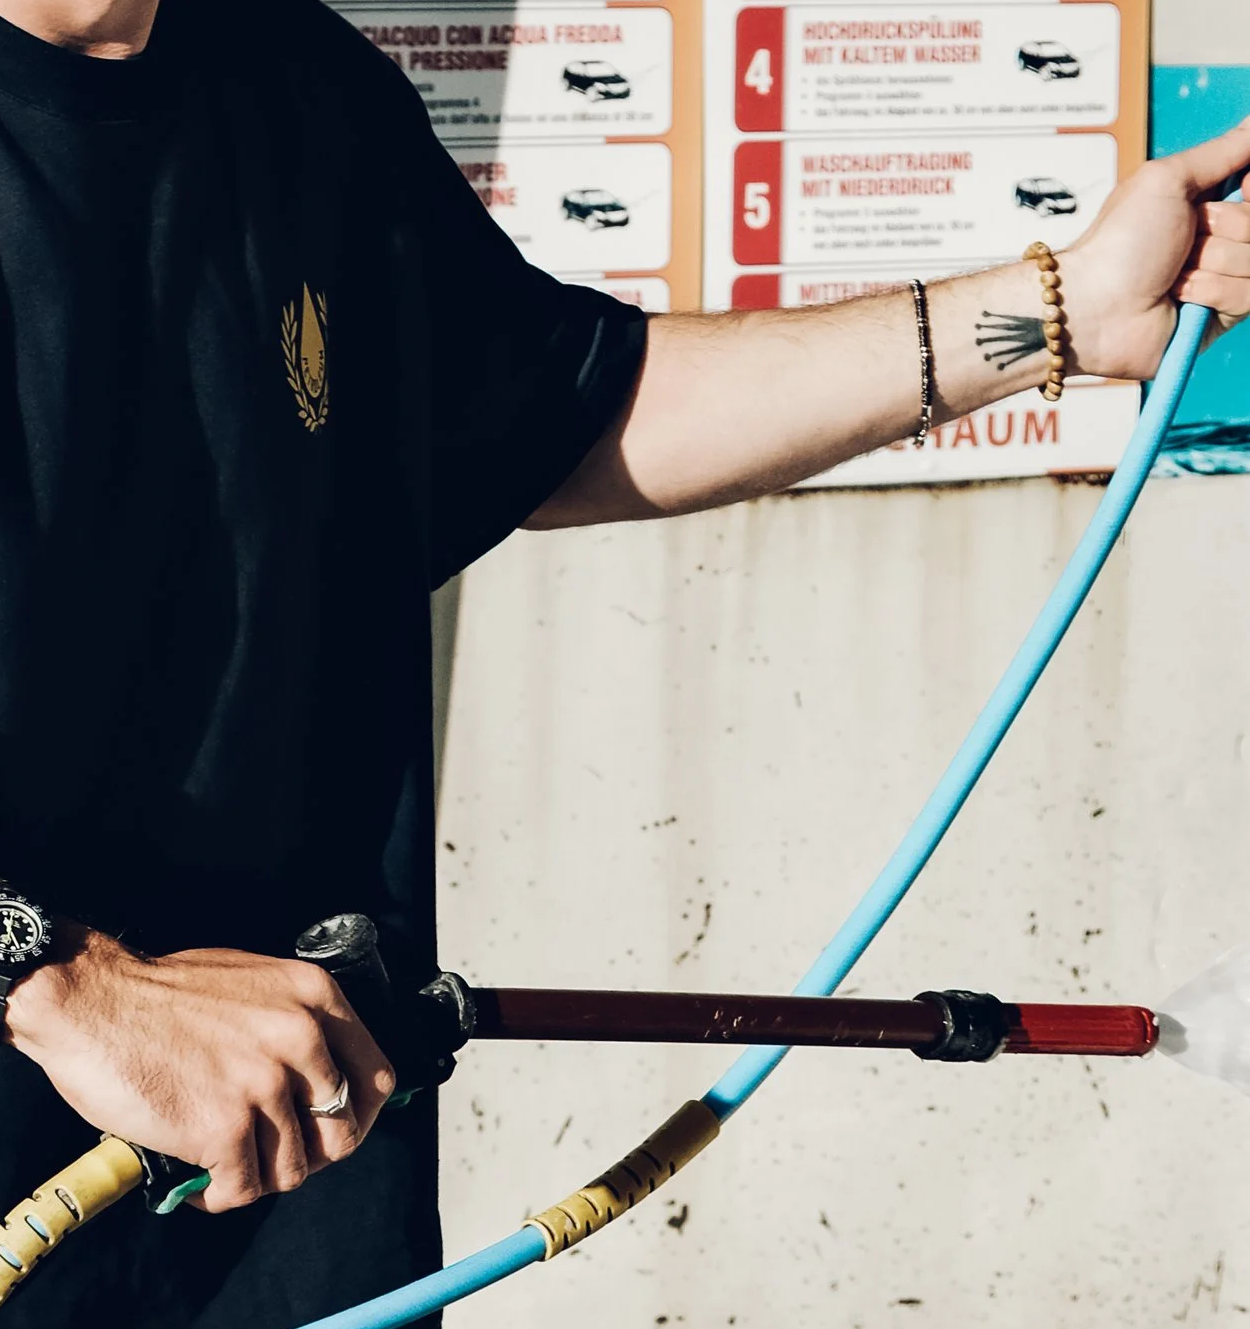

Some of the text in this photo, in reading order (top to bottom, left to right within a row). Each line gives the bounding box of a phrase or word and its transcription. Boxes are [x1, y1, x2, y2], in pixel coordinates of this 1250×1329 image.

[446, 25, 483, 45] CON
[489, 25, 548, 45] ACQUA
[555, 25, 623, 43] FREDDA
[410, 50, 508, 70] PRESSIONE
[803, 44, 981, 64] MIT KALTEM WASSER
[744, 50, 773, 95] 4
[802, 176, 954, 197] MIT NIEDERDRUCK
[744, 183, 771, 229] 5
